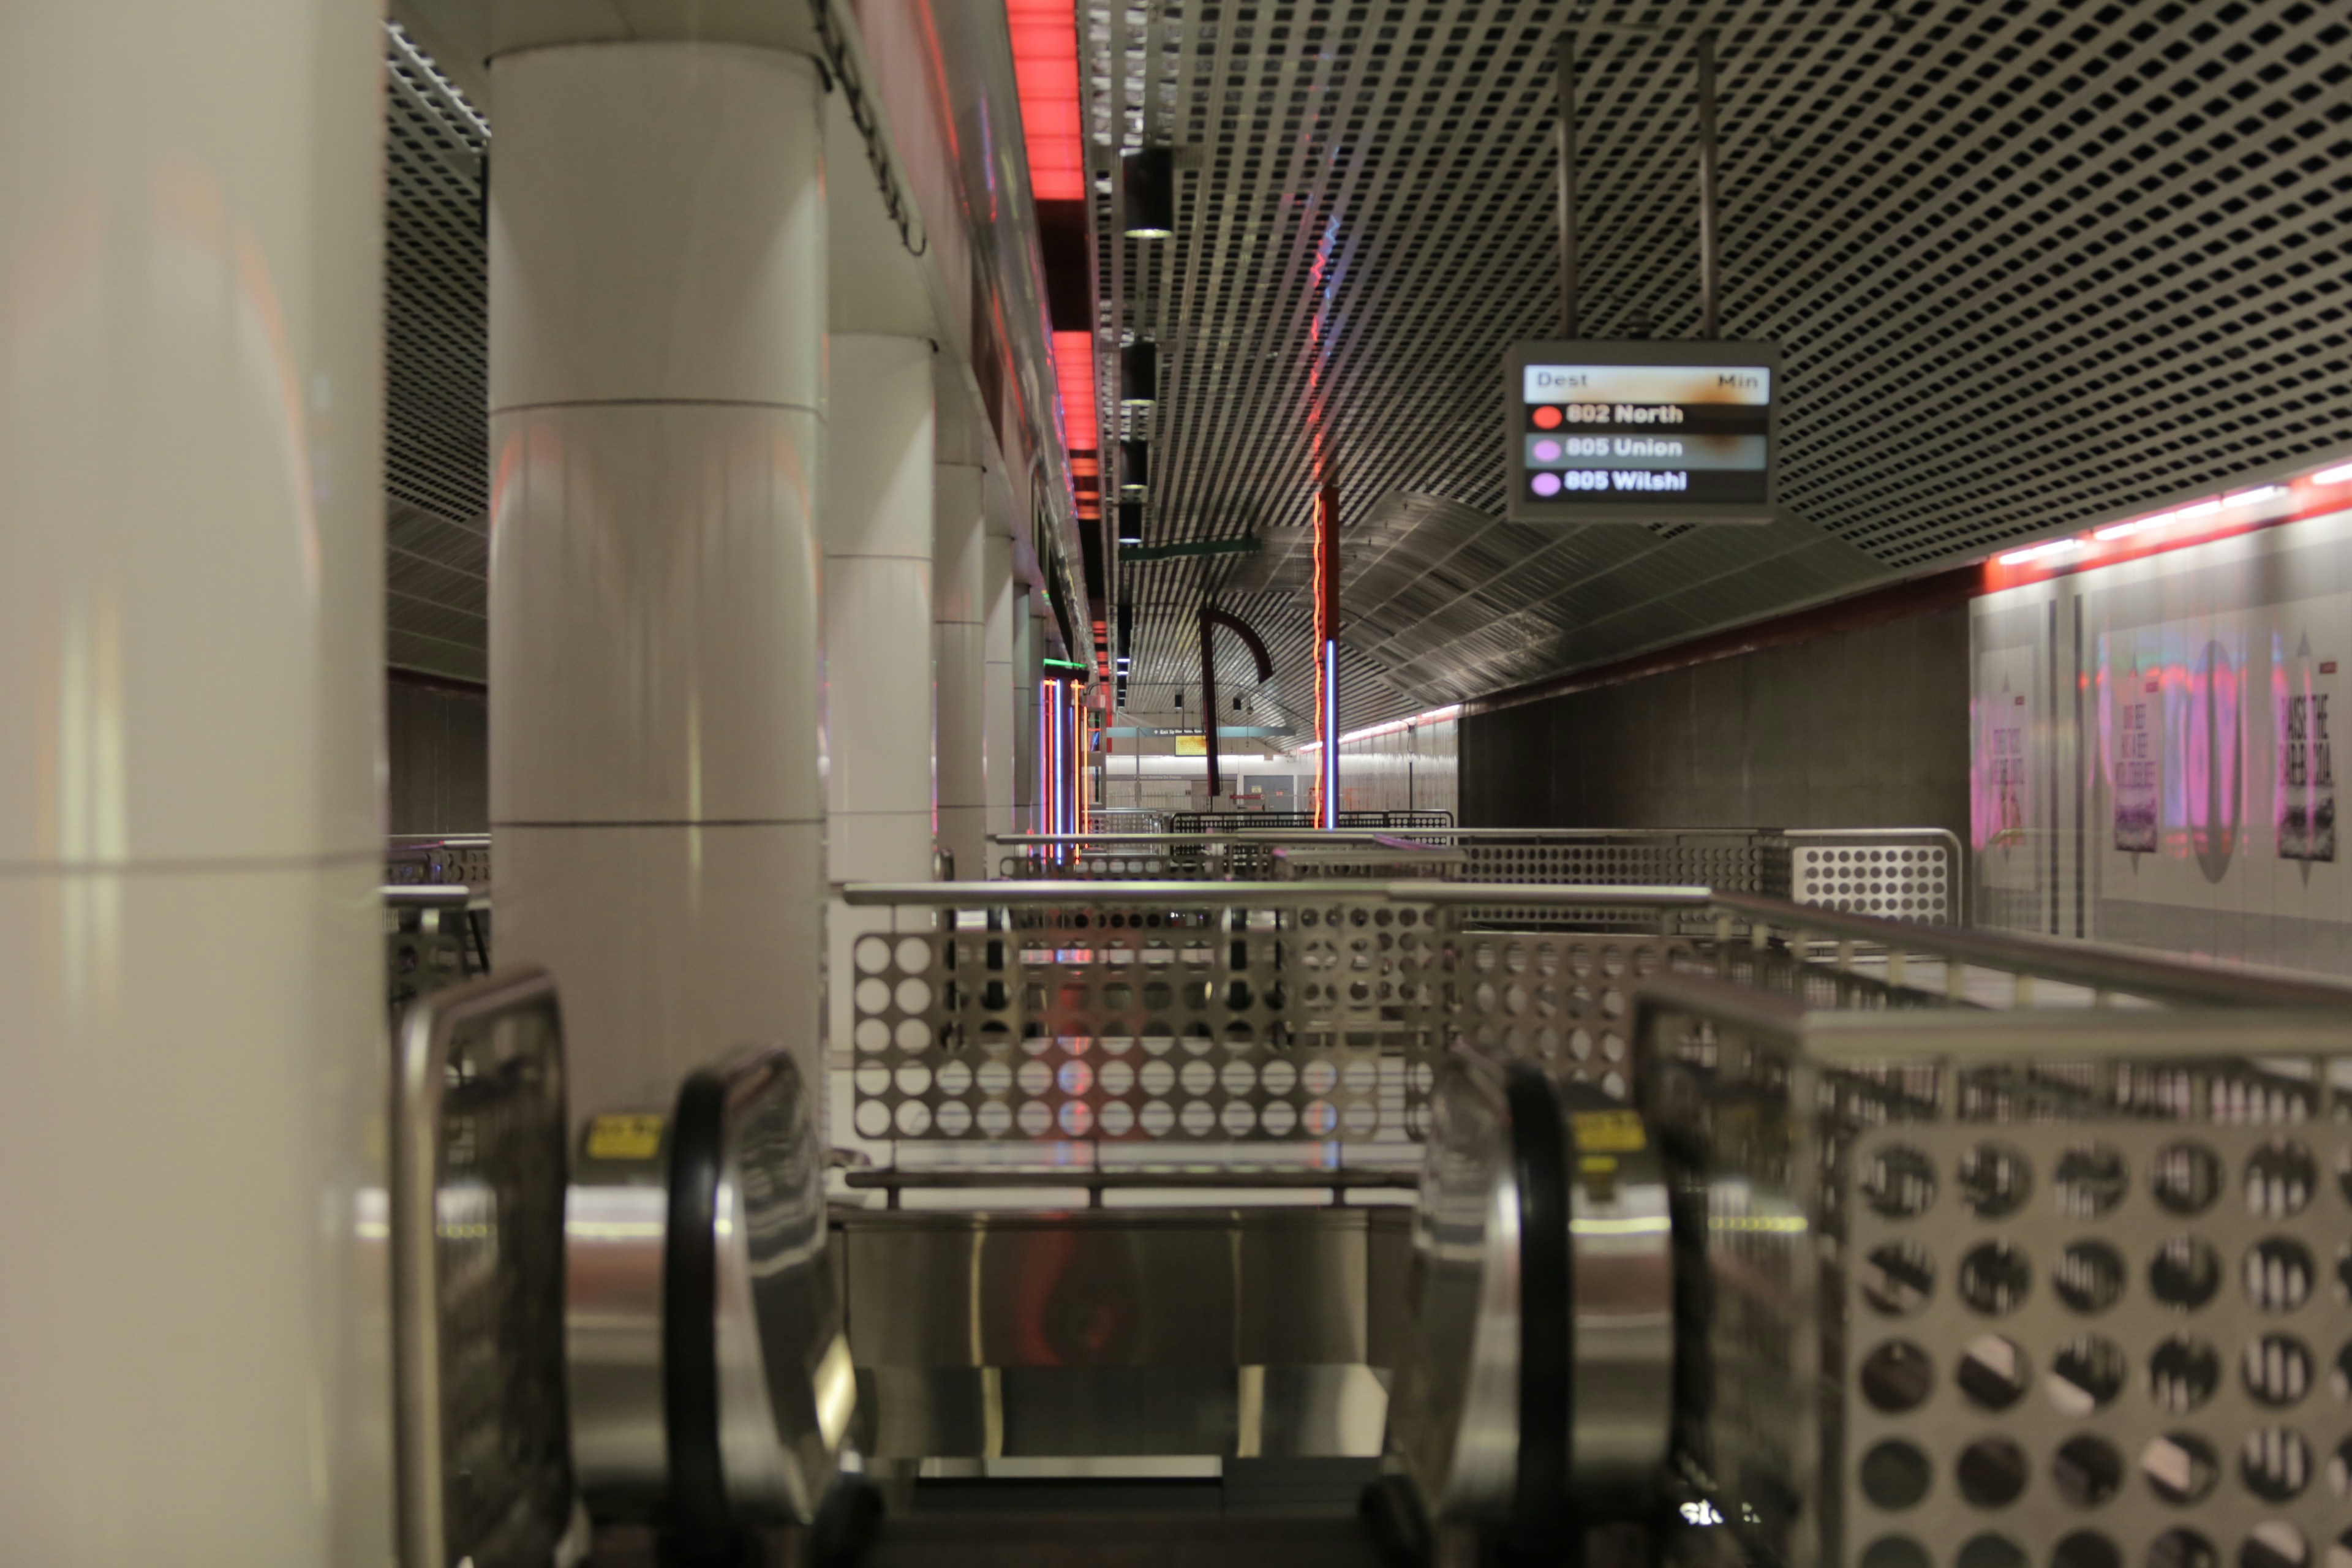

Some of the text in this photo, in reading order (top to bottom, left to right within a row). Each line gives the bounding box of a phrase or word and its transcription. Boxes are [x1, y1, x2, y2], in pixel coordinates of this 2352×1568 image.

[1537, 372, 1758, 388] Dest Min
[1566, 404, 1684, 423] 802 North
[1566, 437, 1683, 456] 805 Union
[1564, 470, 1687, 491] 805 Wilshi
